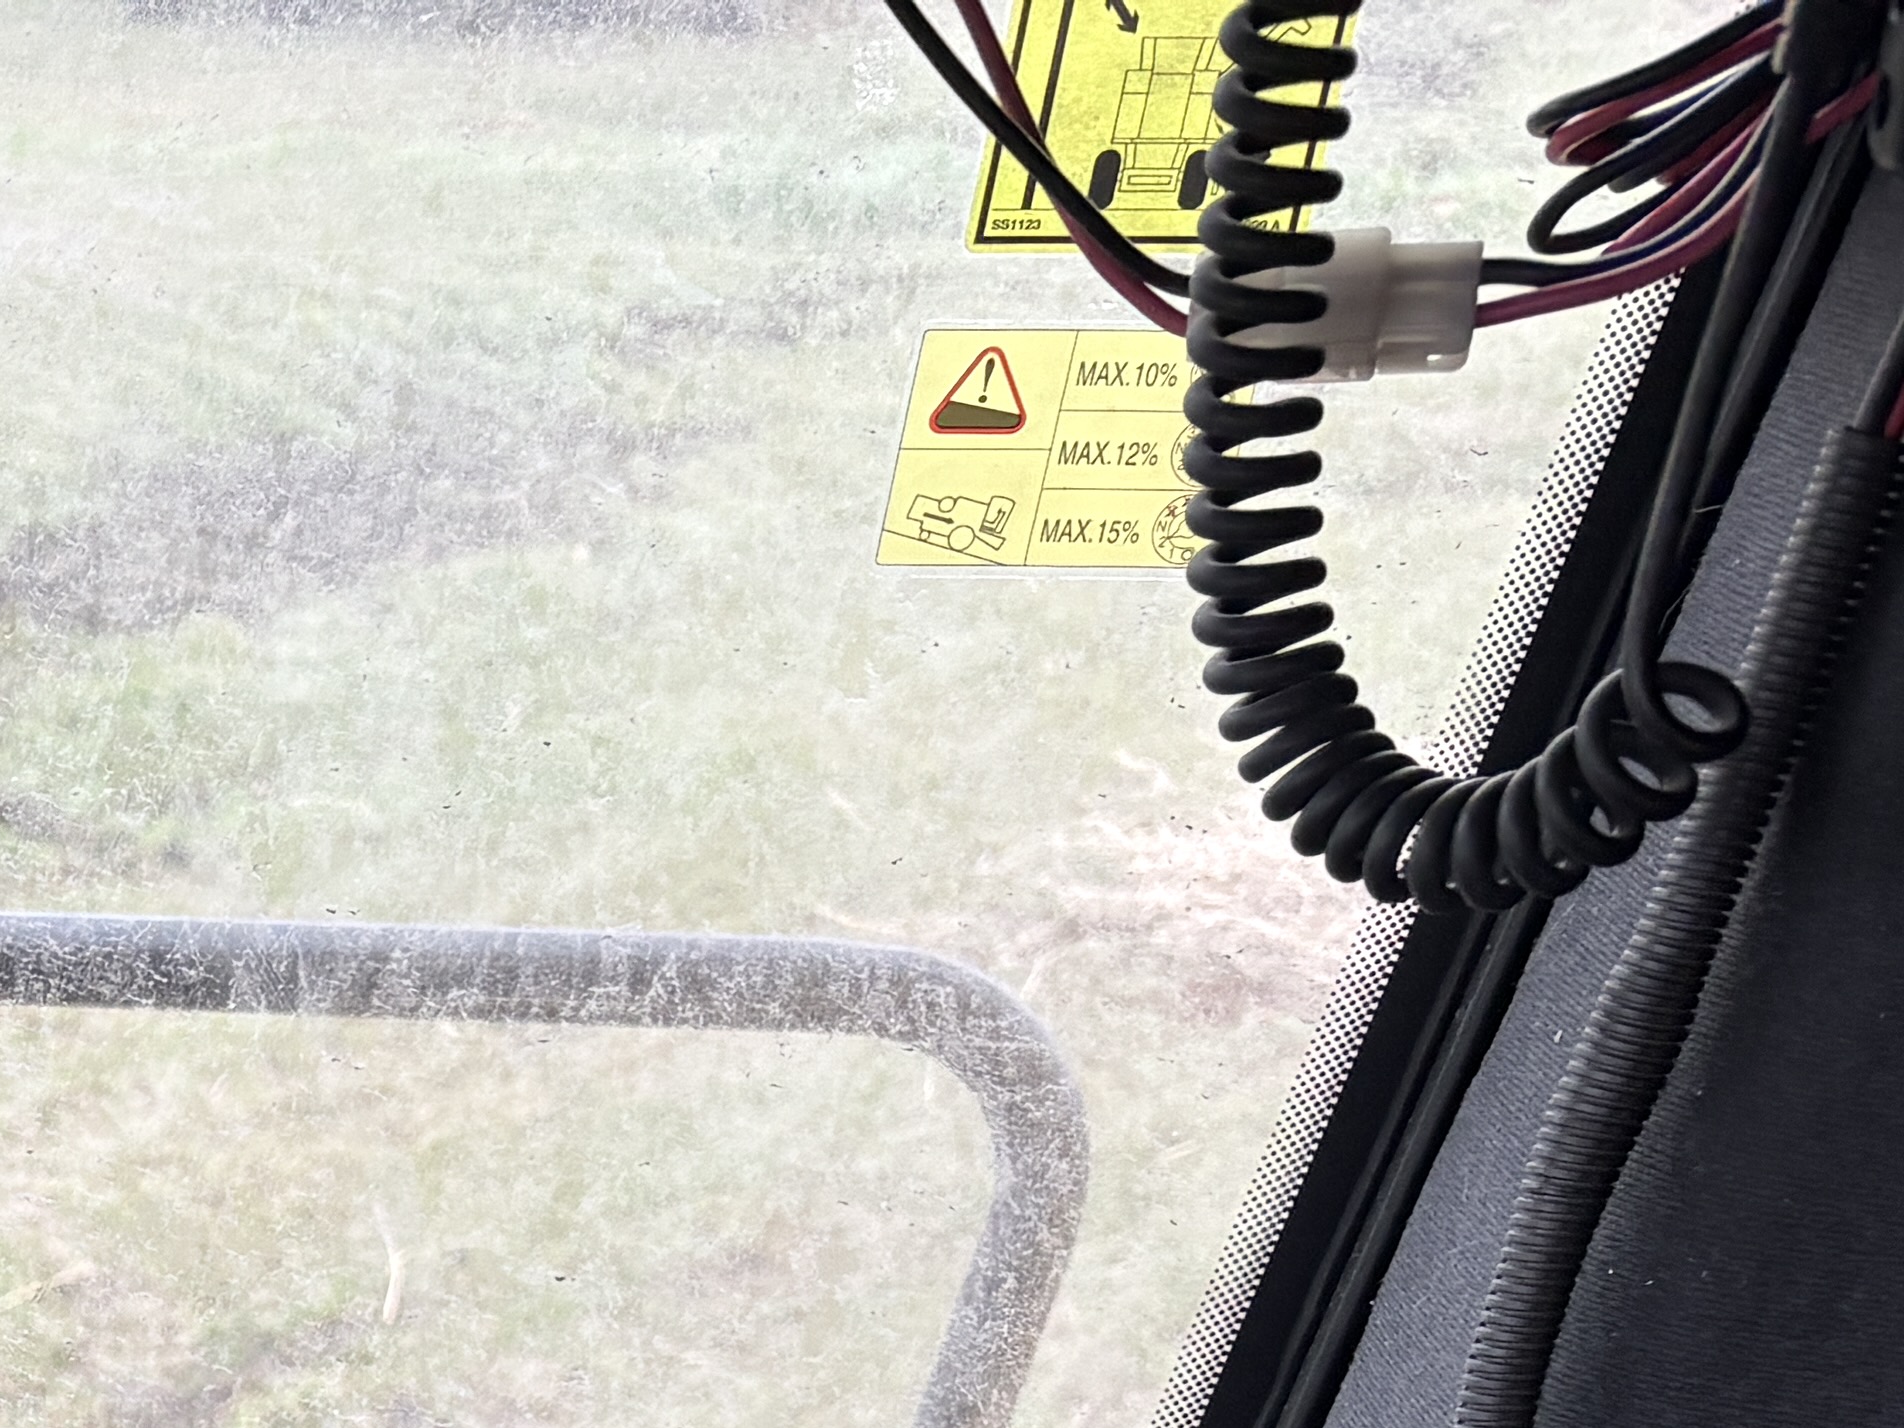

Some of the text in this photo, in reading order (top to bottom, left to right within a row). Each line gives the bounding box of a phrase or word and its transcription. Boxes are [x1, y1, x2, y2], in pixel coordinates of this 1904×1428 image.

[1076, 361, 1178, 387] MAX.10%
[1058, 440, 1158, 466] MAX.12%
[1040, 518, 1140, 545] MAX.15%
